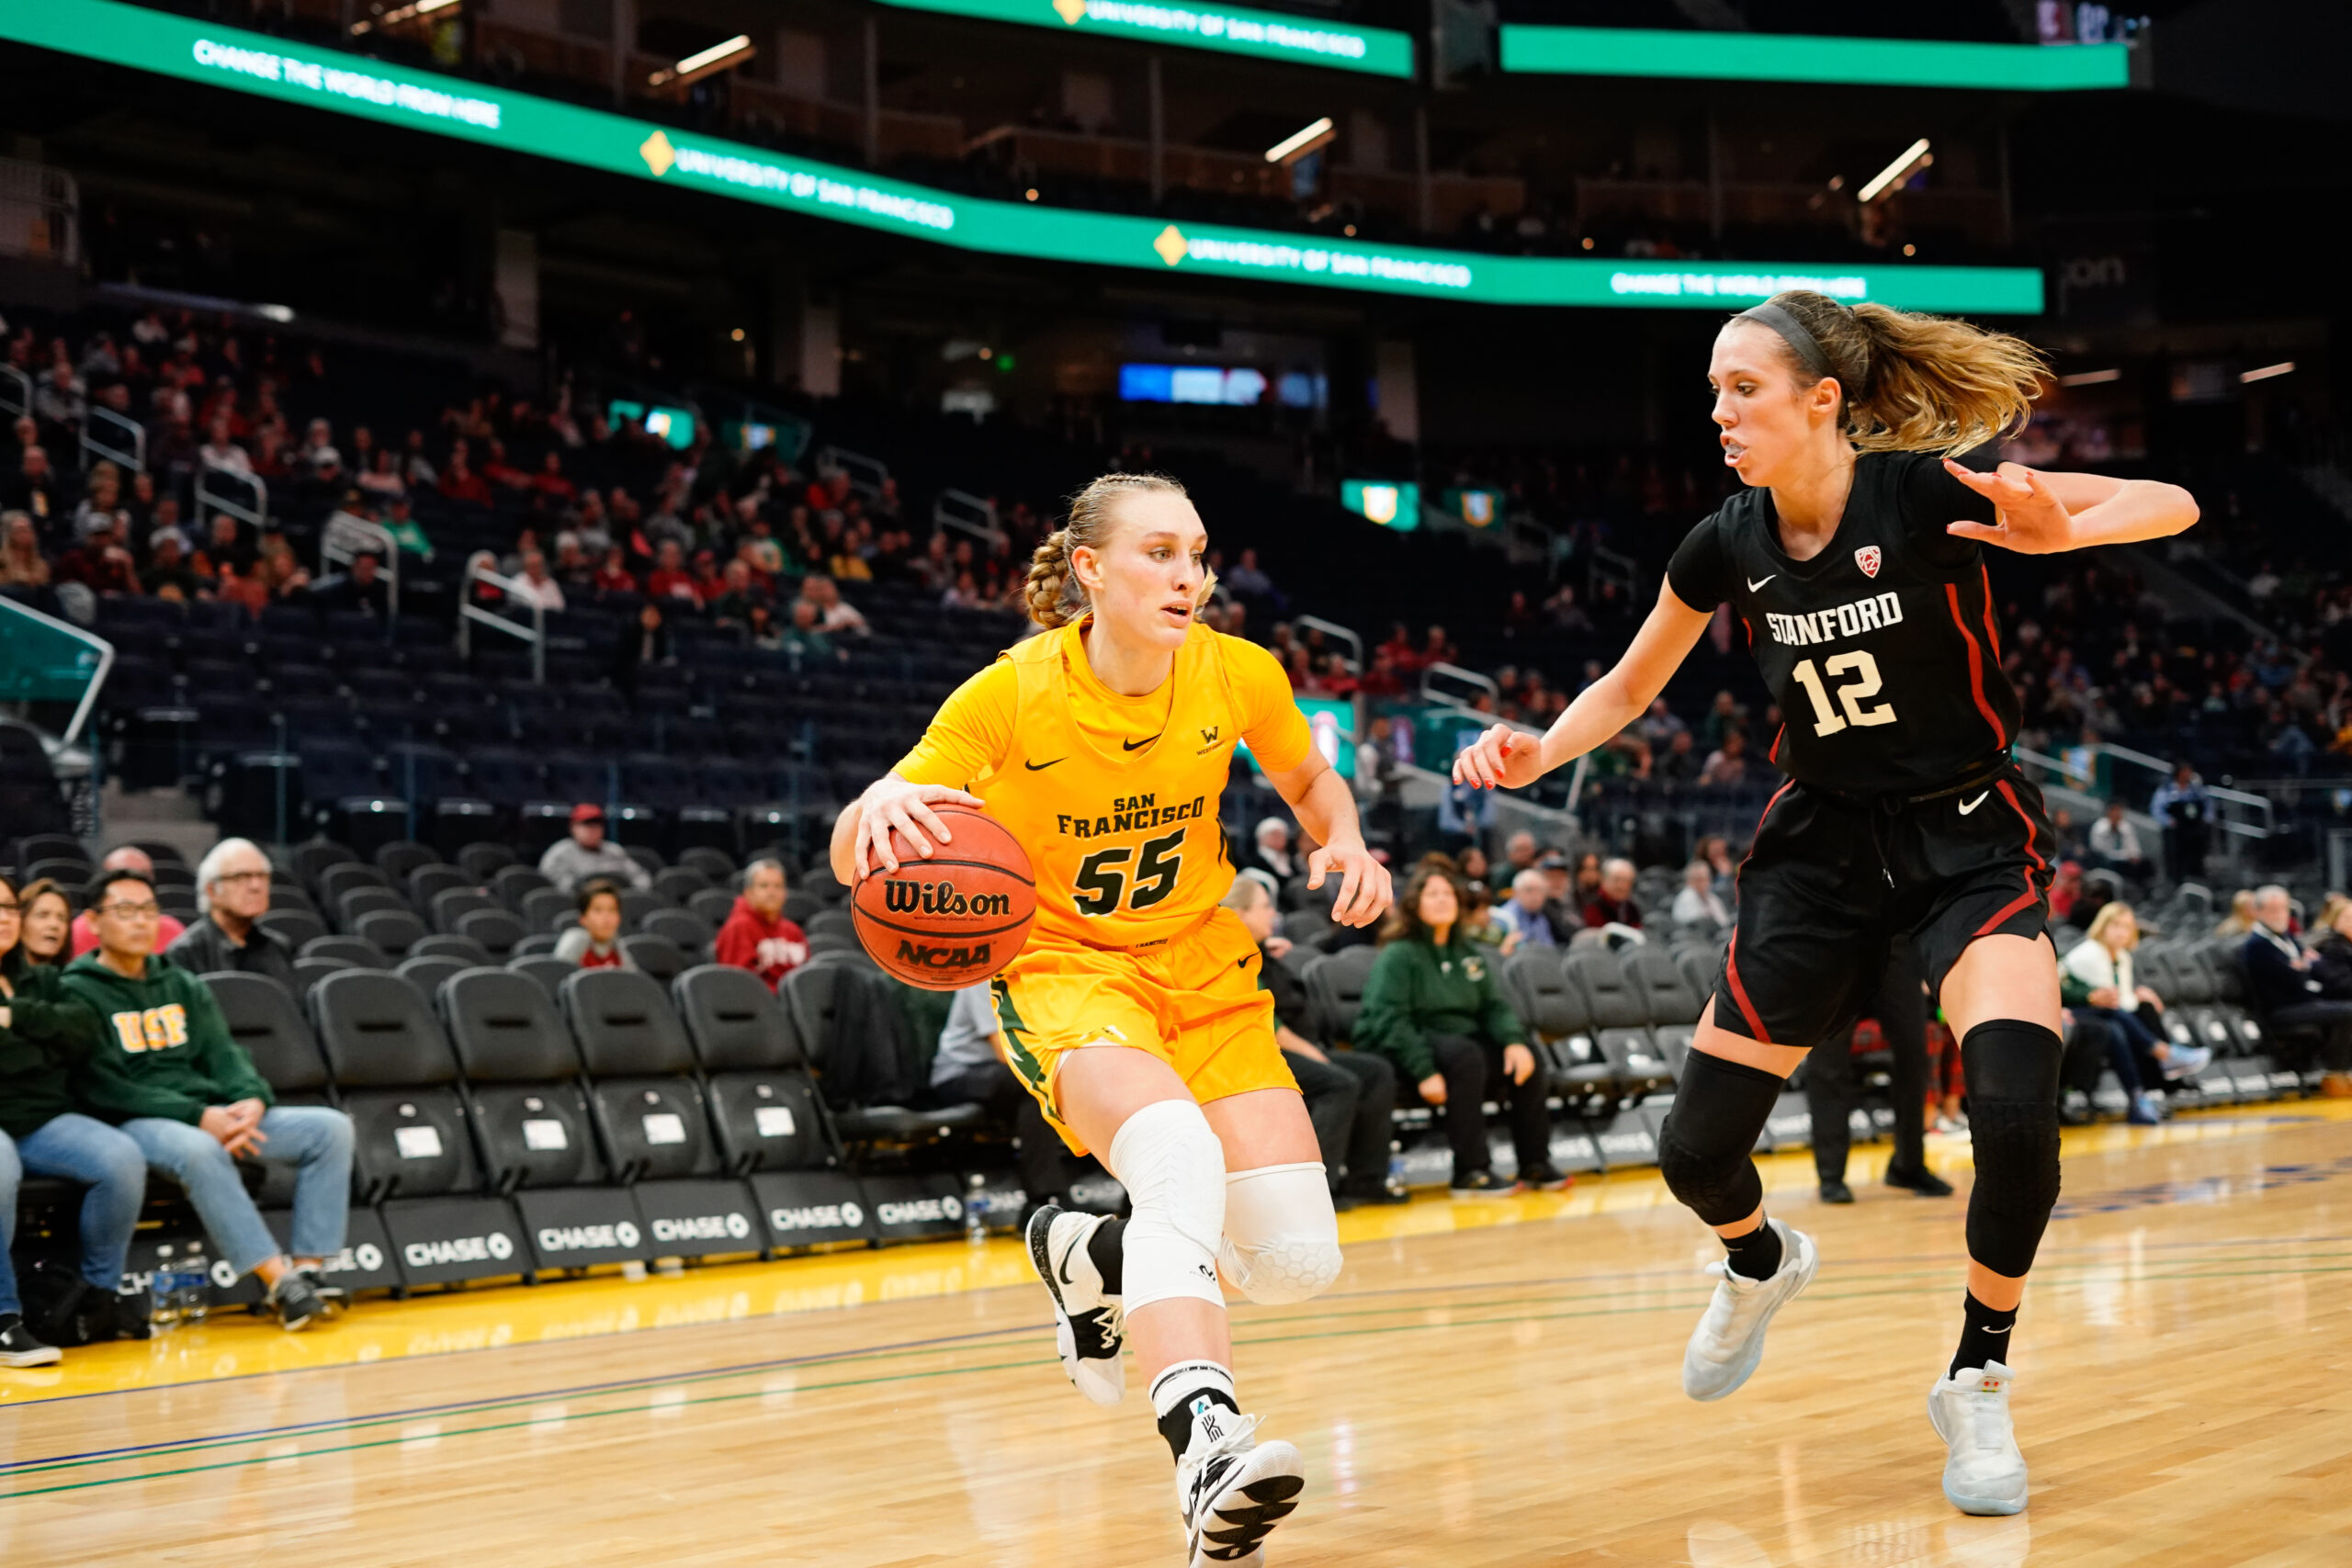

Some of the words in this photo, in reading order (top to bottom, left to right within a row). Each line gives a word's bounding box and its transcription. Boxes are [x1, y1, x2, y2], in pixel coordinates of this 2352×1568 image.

[1086, 1, 1197, 31] UNIVERSITY
[1199, 14, 1225, 36] OF
[1226, 17, 1264, 42] SAN
[1266, 24, 1365, 58] FRANCISCO
[193, 39, 281, 81] CHANGE
[283, 57, 322, 90] THE
[322, 68, 396, 106] WORLD
[396, 83, 451, 118] FROM
[452, 97, 501, 129] HERE
[675, 148, 788, 191] UNIVERSITY
[789, 173, 817, 197] OF
[818, 178, 855, 208] SAN
[857, 187, 954, 230] FRANCISCO
[1188, 238, 1301, 267] UNIVERSITY
[1302, 248, 1329, 272] OF
[1331, 252, 1369, 275] SAN
[1371, 255, 1471, 288] FRANCISCO
[1611, 273, 1681, 295] CHANGE
[1683, 274, 1715, 296] THE
[1716, 275, 1774, 298] WORLD
[1766, 592, 1904, 646] STANFORD
[1792, 649, 1897, 738] 12
[1201, 726, 1218, 744] W
[1057, 795, 1204, 839] FRANCISCO
[1114, 794, 1155, 812] SAN
[1072, 826, 1189, 917] 55
[884, 879, 1011, 917] Wilson
[896, 940, 990, 969] NCAA
[111, 1003, 188, 1054] USF
[652, 1215, 729, 1242] CHASE
[771, 1205, 842, 1231] CHASE
[876, 1199, 943, 1225] CHASE
[404, 1236, 490, 1267] CHASE
[537, 1224, 617, 1251] CHASE
